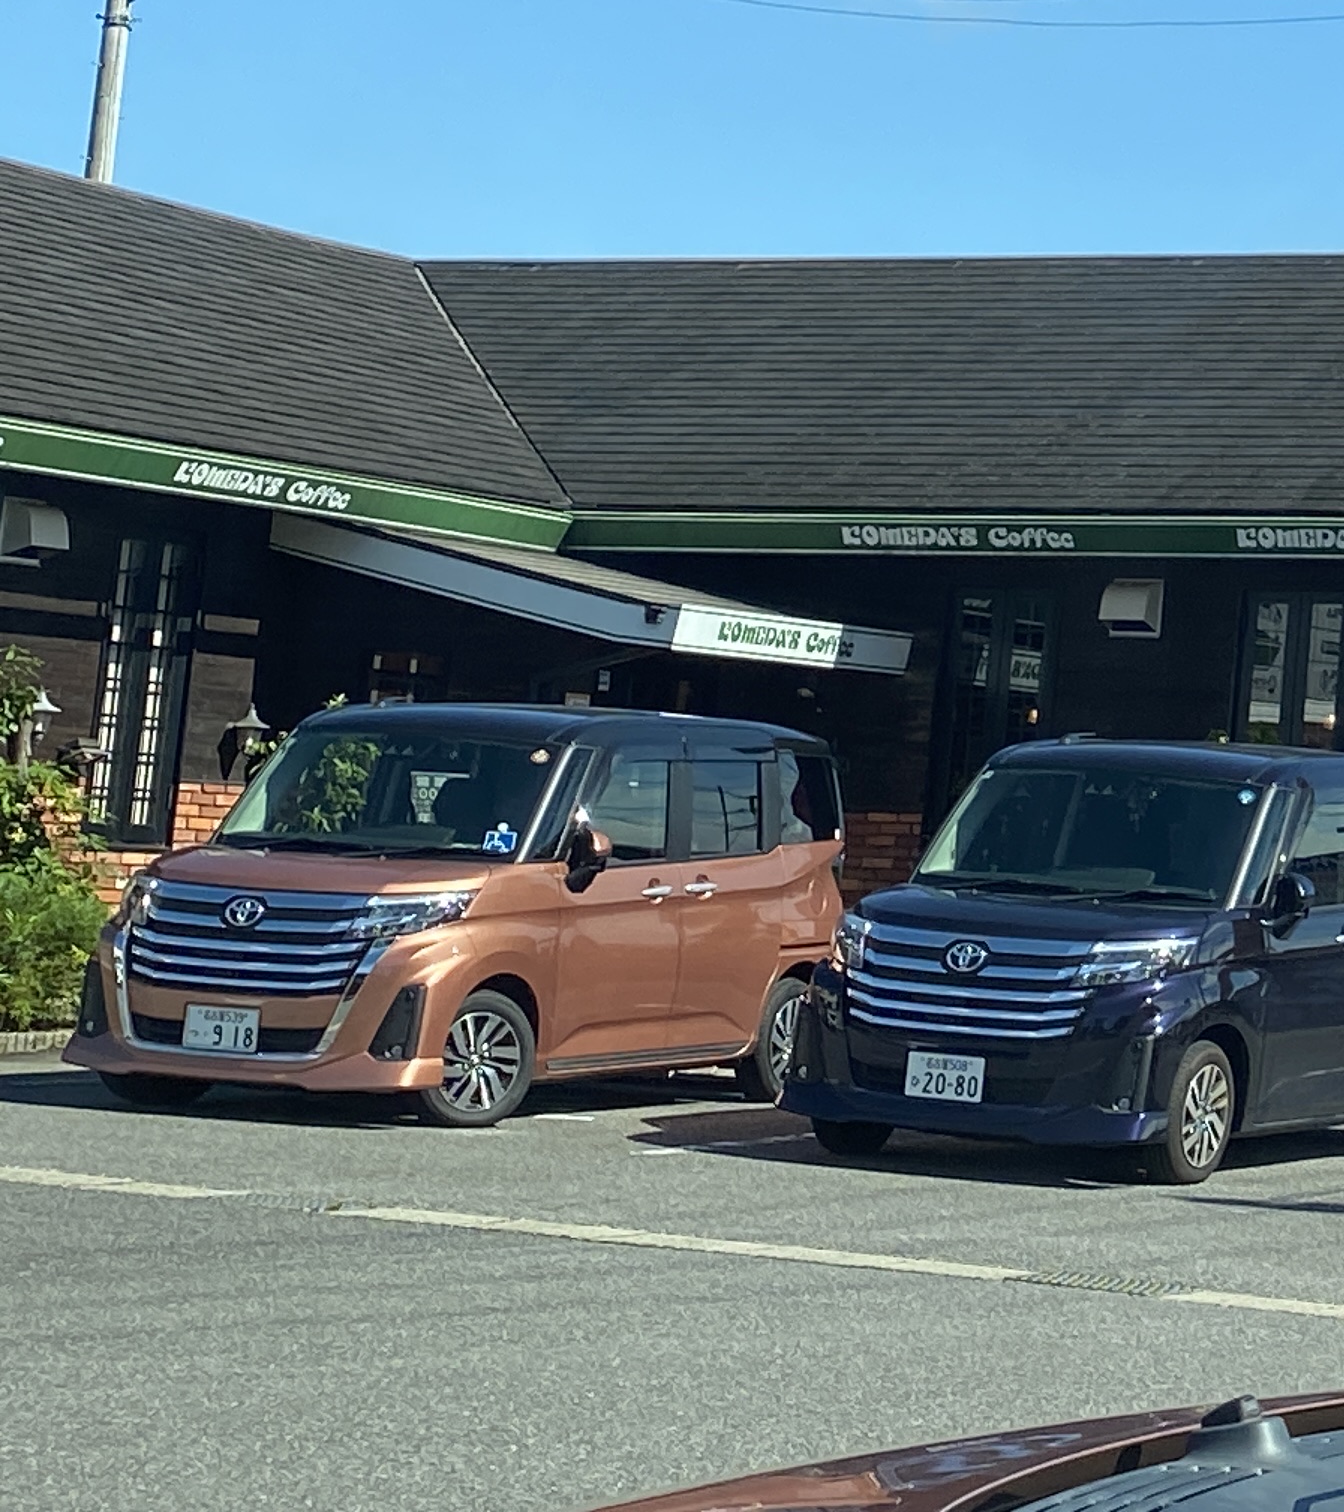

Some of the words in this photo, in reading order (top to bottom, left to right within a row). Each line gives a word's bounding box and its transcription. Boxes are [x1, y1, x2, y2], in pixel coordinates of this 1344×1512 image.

[173, 461, 285, 497] KOMEDA'S
[841, 525, 978, 548] KOMEDA'S
[921, 1071, 978, 1098] 20-80
